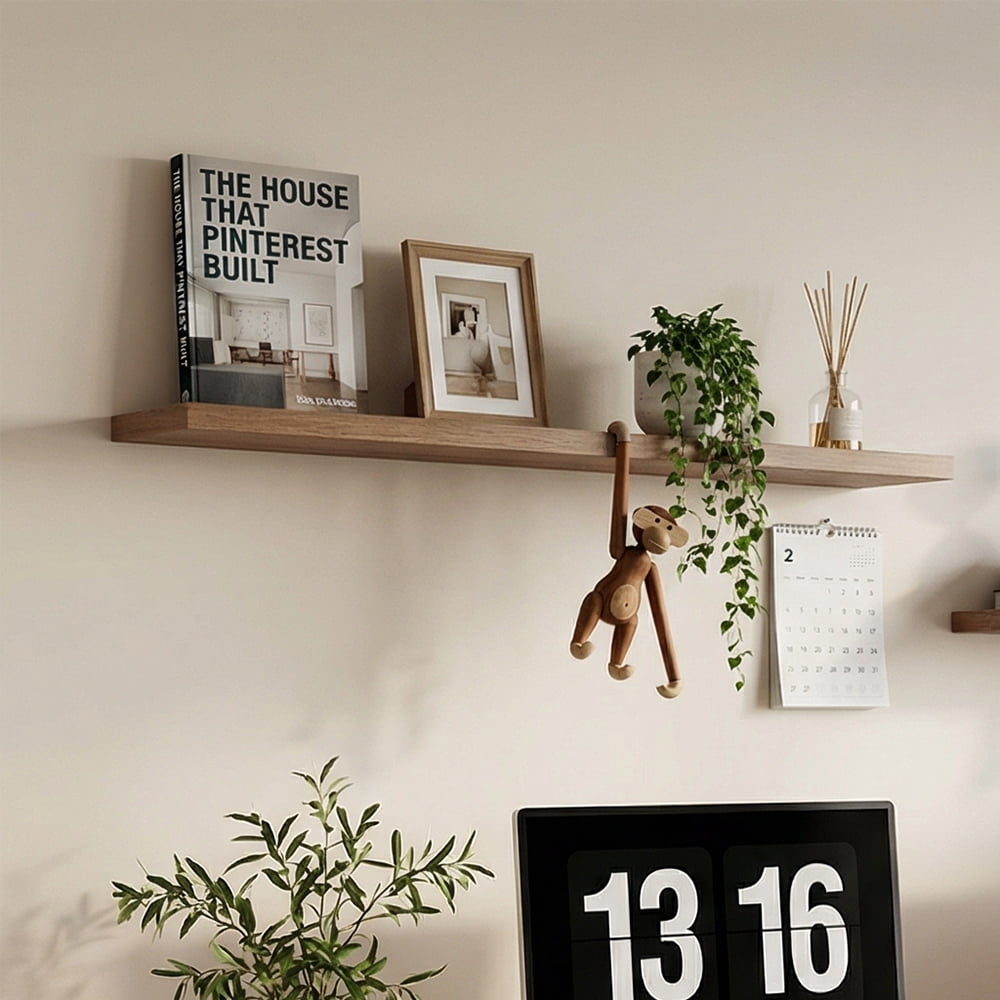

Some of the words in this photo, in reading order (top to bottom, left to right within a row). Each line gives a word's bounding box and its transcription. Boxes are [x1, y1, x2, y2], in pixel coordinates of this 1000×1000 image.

[200, 168, 251, 198] THE
[261, 176, 349, 210] HOUSE
[201, 197, 270, 227] THAT
[202, 225, 349, 264] PINTEREST
[204, 253, 279, 284] BUILT
[783, 548, 794, 563] 2
[738, 863, 849, 995] 16
